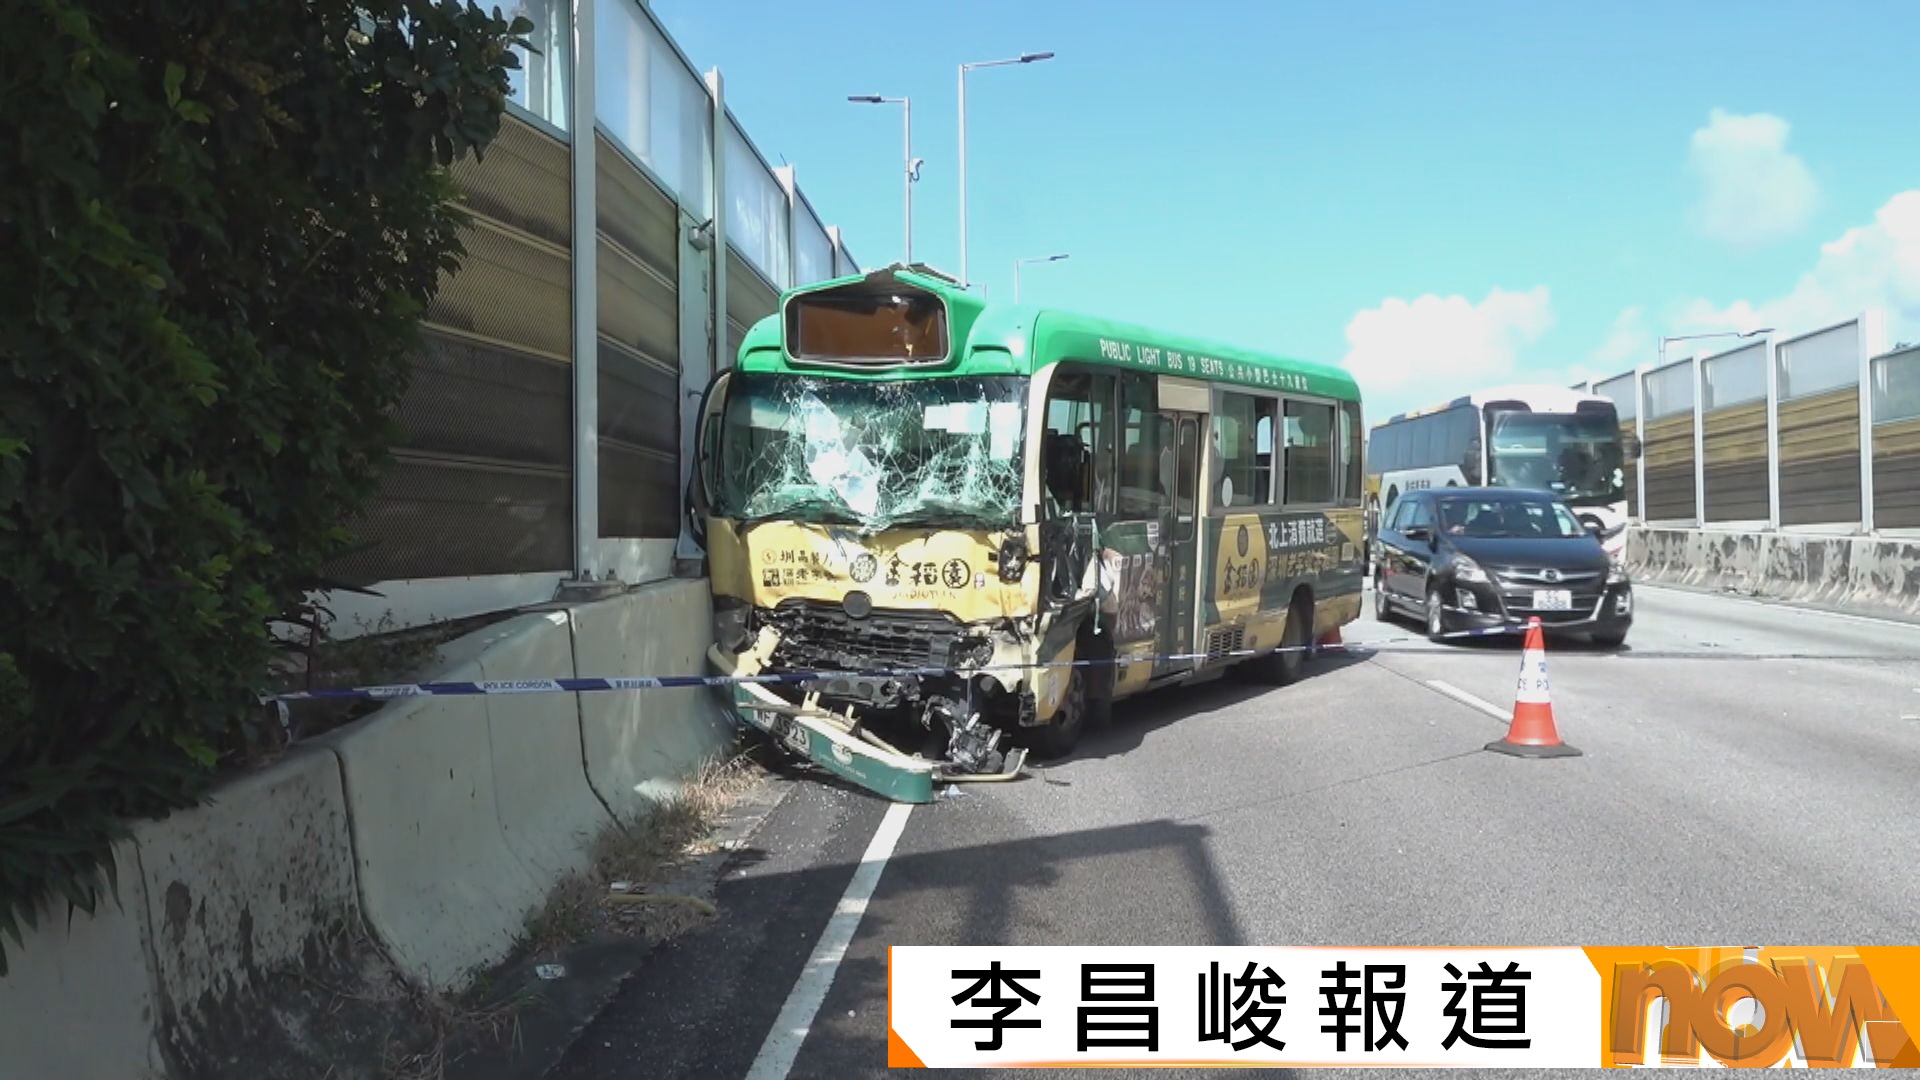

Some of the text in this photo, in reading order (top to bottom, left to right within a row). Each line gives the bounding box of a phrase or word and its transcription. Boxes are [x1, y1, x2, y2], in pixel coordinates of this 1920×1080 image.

[1099, 338, 1223, 376] PUBLIC LIGHT BUS 19 SEATS
[483, 680, 552, 690] POLICE CORDON
